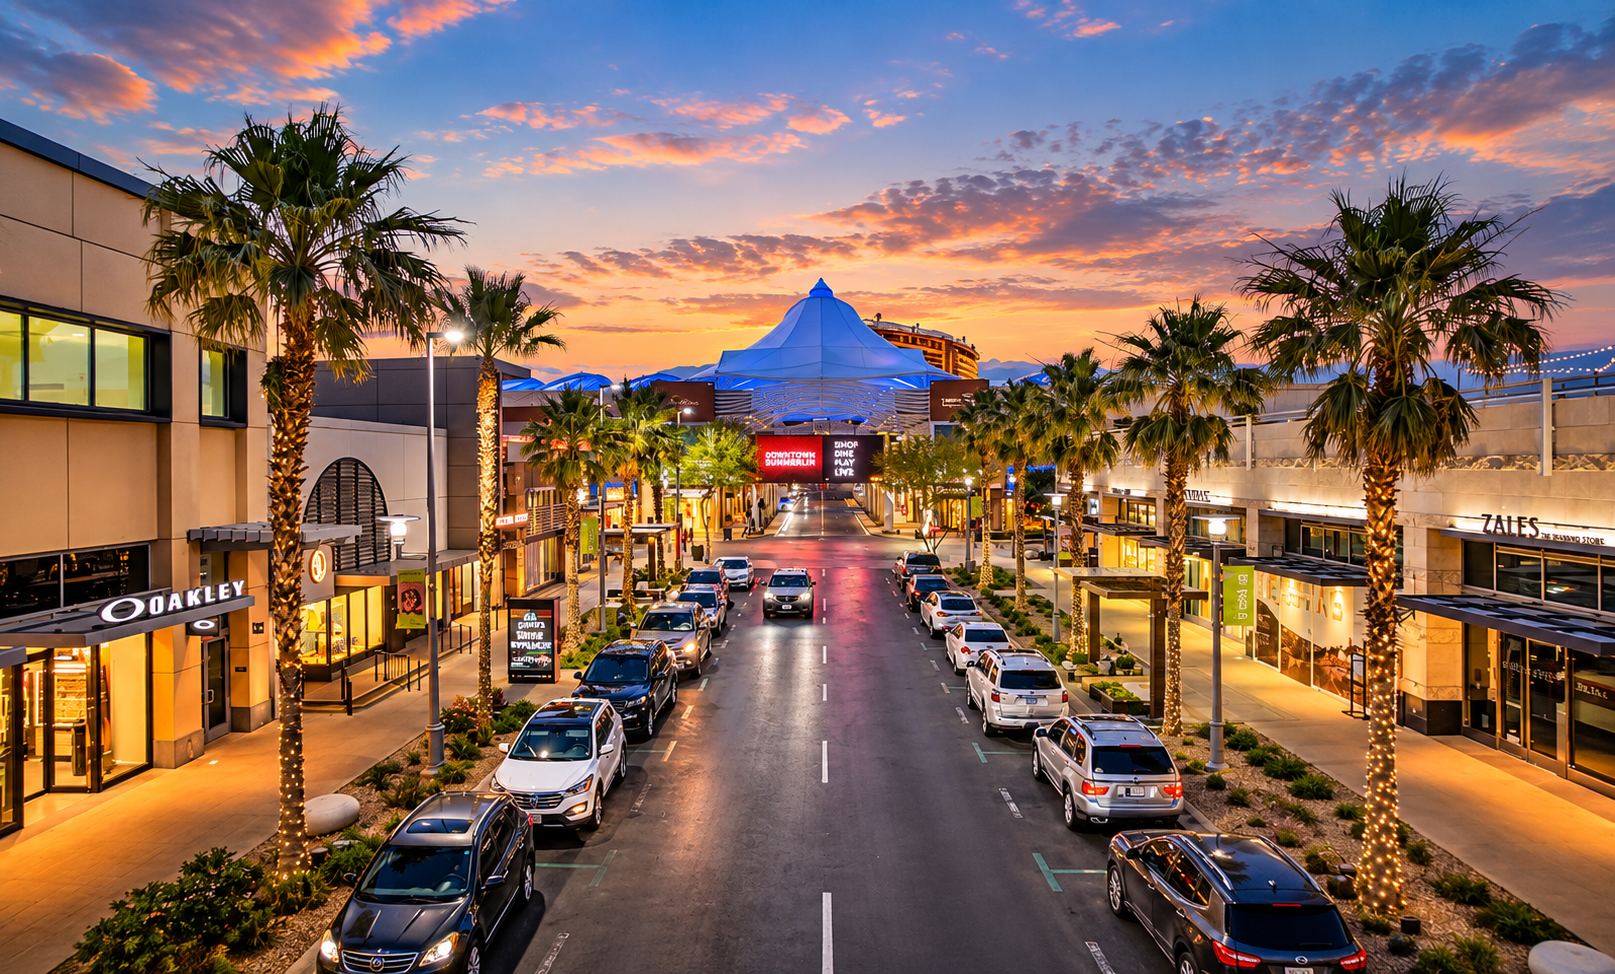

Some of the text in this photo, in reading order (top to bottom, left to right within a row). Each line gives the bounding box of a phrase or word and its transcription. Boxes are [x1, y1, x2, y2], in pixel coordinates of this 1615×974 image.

[765, 451, 816, 459] DOWNTOWN
[1481, 513, 1540, 539] ZALES
[149, 579, 245, 615] OAKLEY
